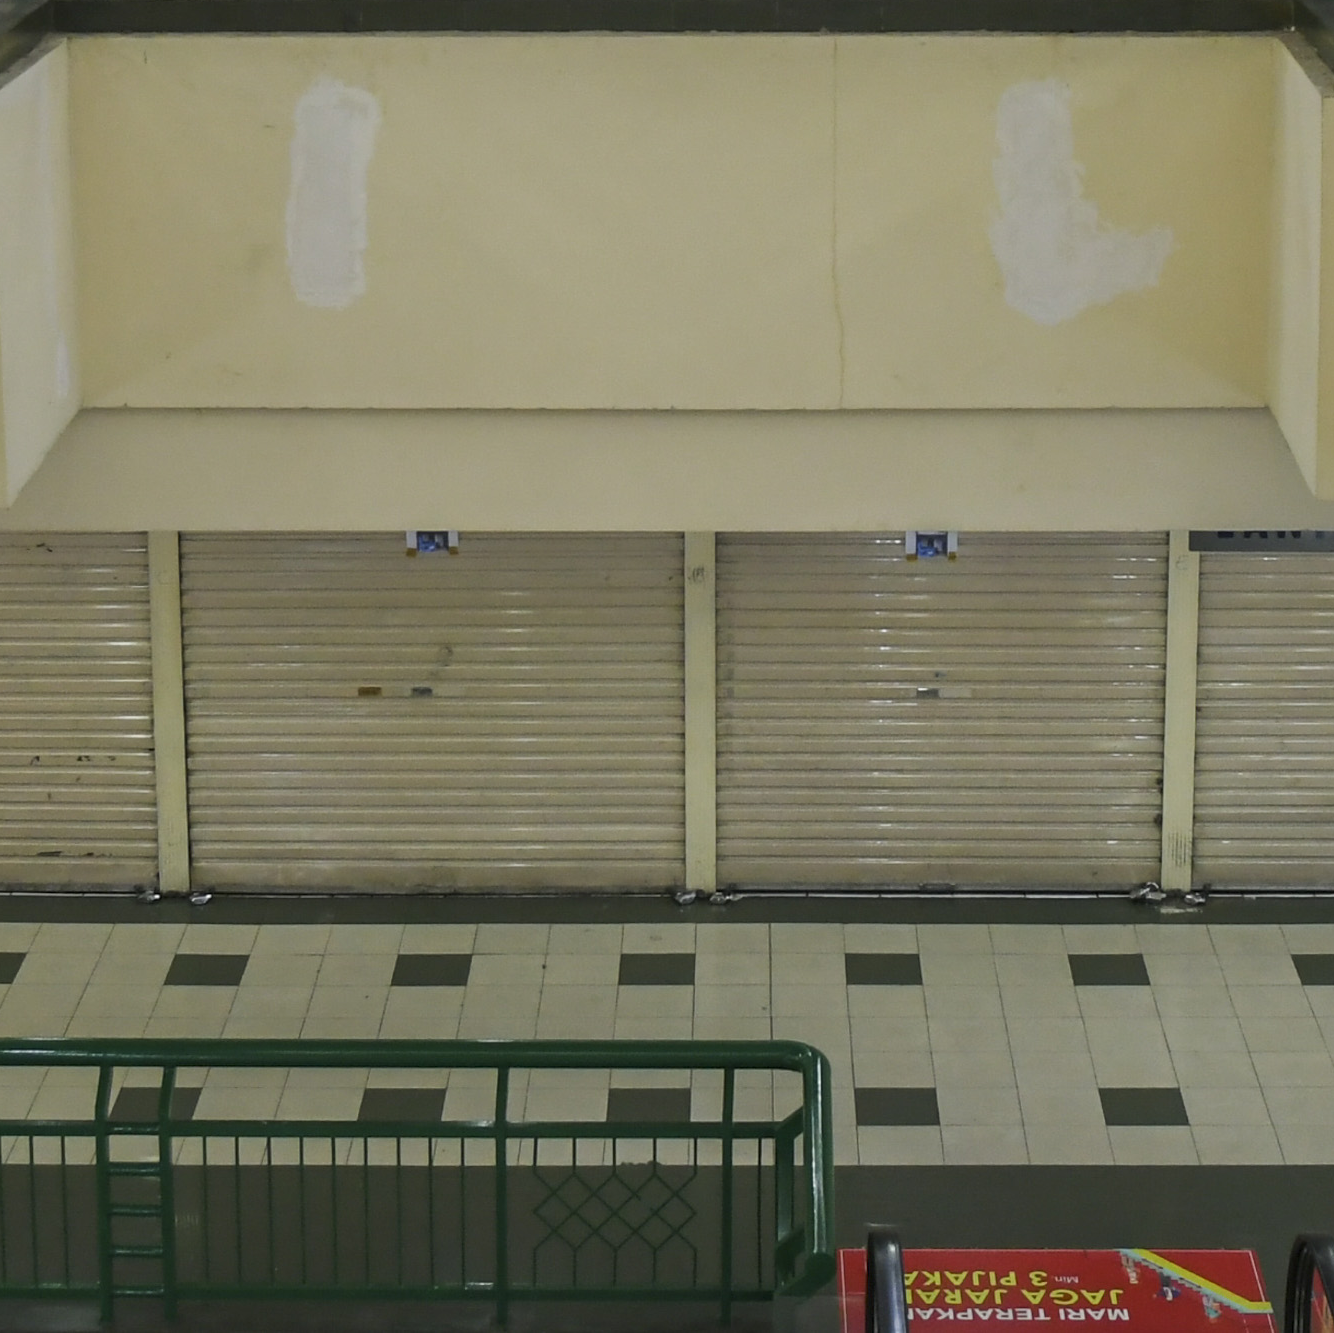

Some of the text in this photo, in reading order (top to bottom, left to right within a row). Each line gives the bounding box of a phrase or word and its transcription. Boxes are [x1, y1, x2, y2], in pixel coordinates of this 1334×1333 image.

[1028, 1270, 1048, 1286] 3
[1019, 1289, 1124, 1305] JAGA
[1059, 1308, 1130, 1321] MARI
